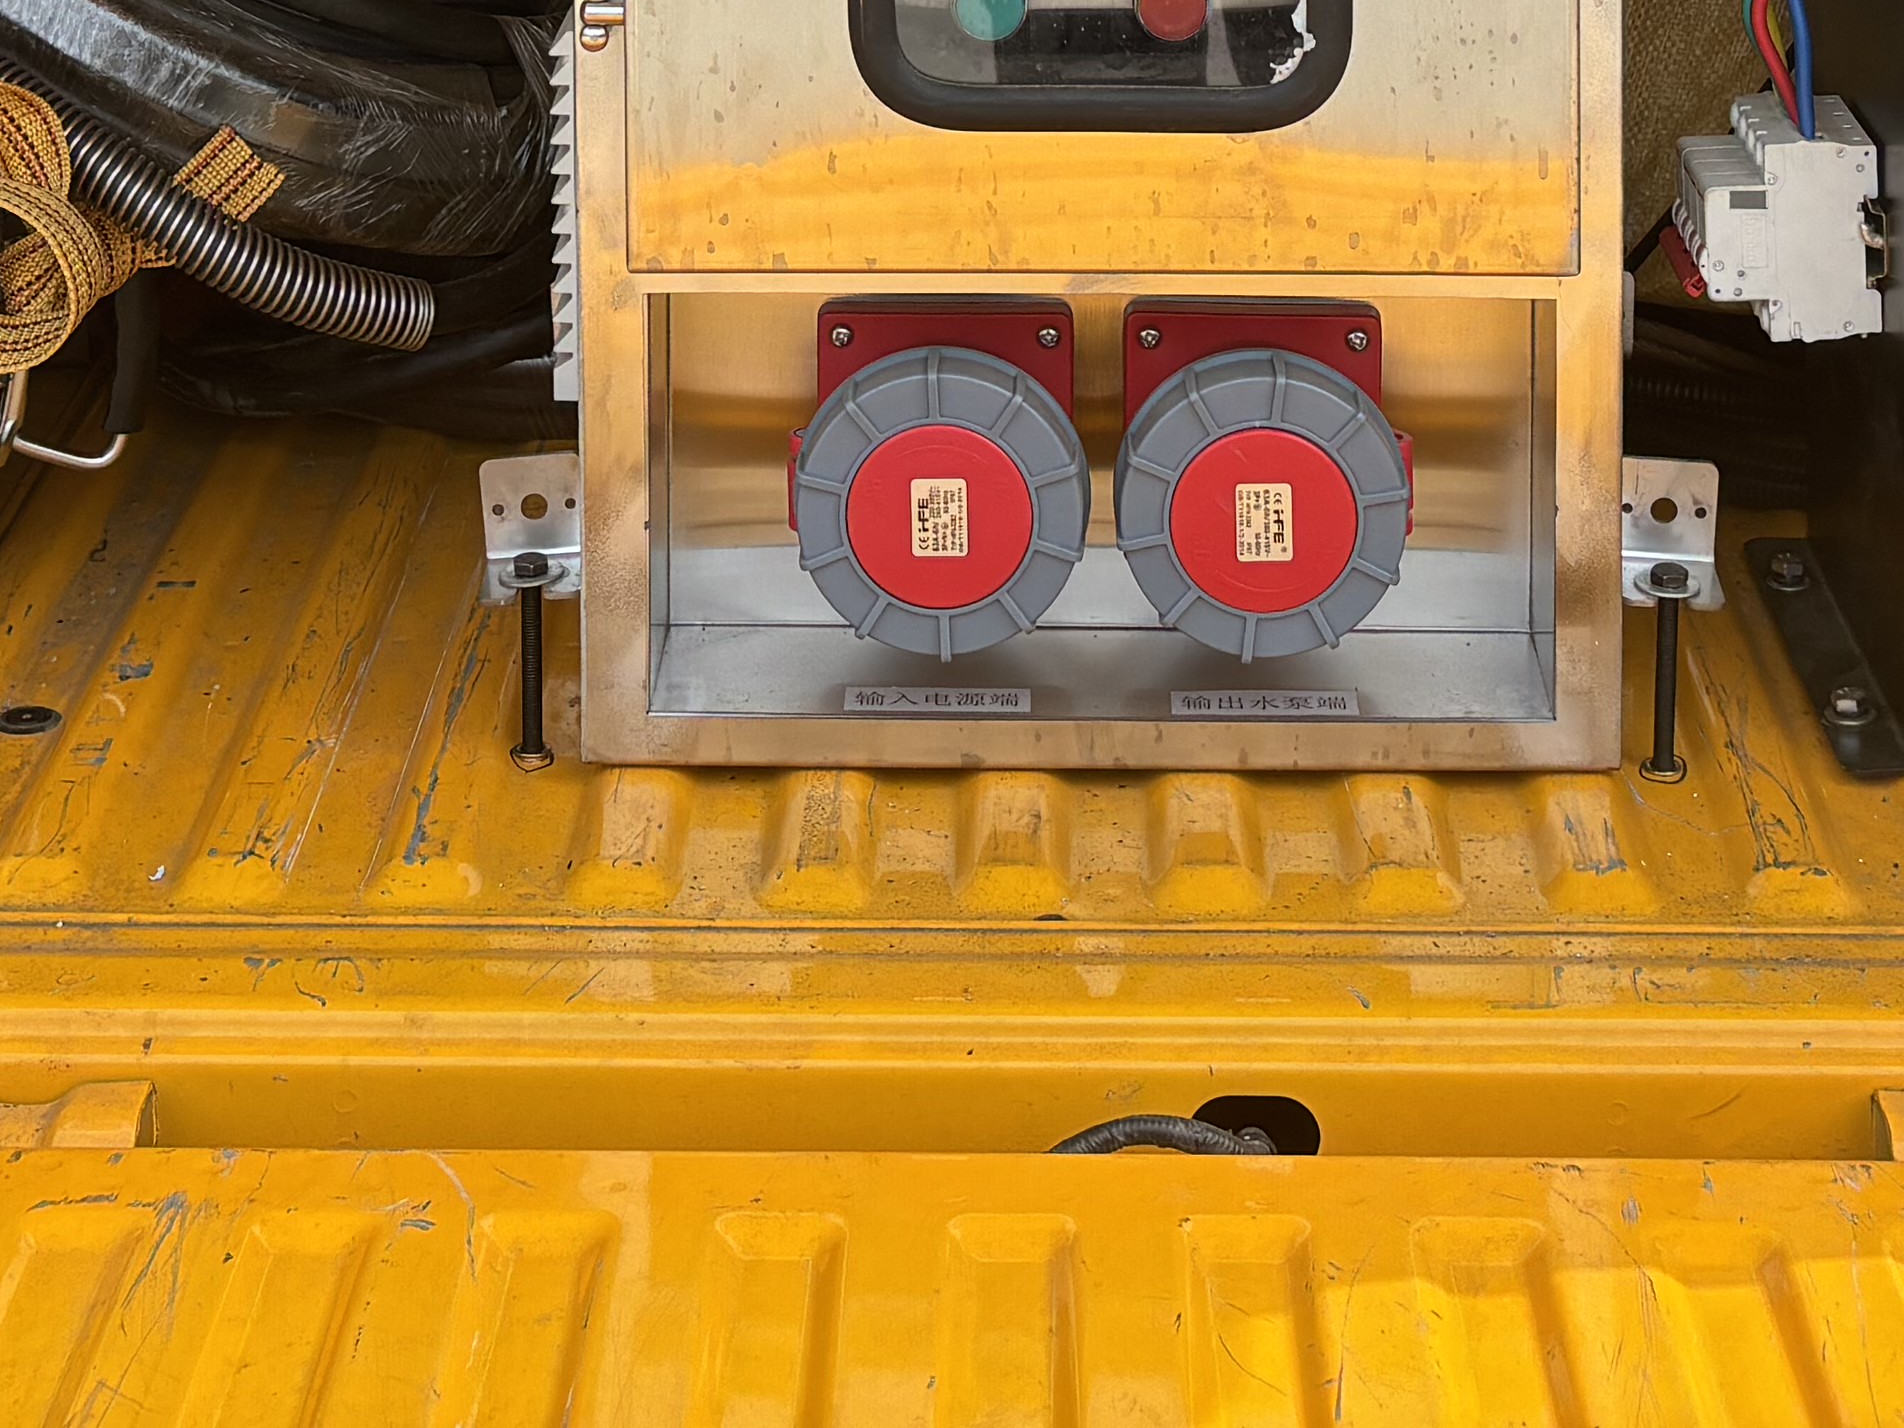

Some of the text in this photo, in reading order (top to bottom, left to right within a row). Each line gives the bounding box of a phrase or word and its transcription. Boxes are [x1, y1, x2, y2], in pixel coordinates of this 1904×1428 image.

[854, 691, 1020, 708] 输入电源端
[1181, 694, 1348, 712] 输出水泵端
